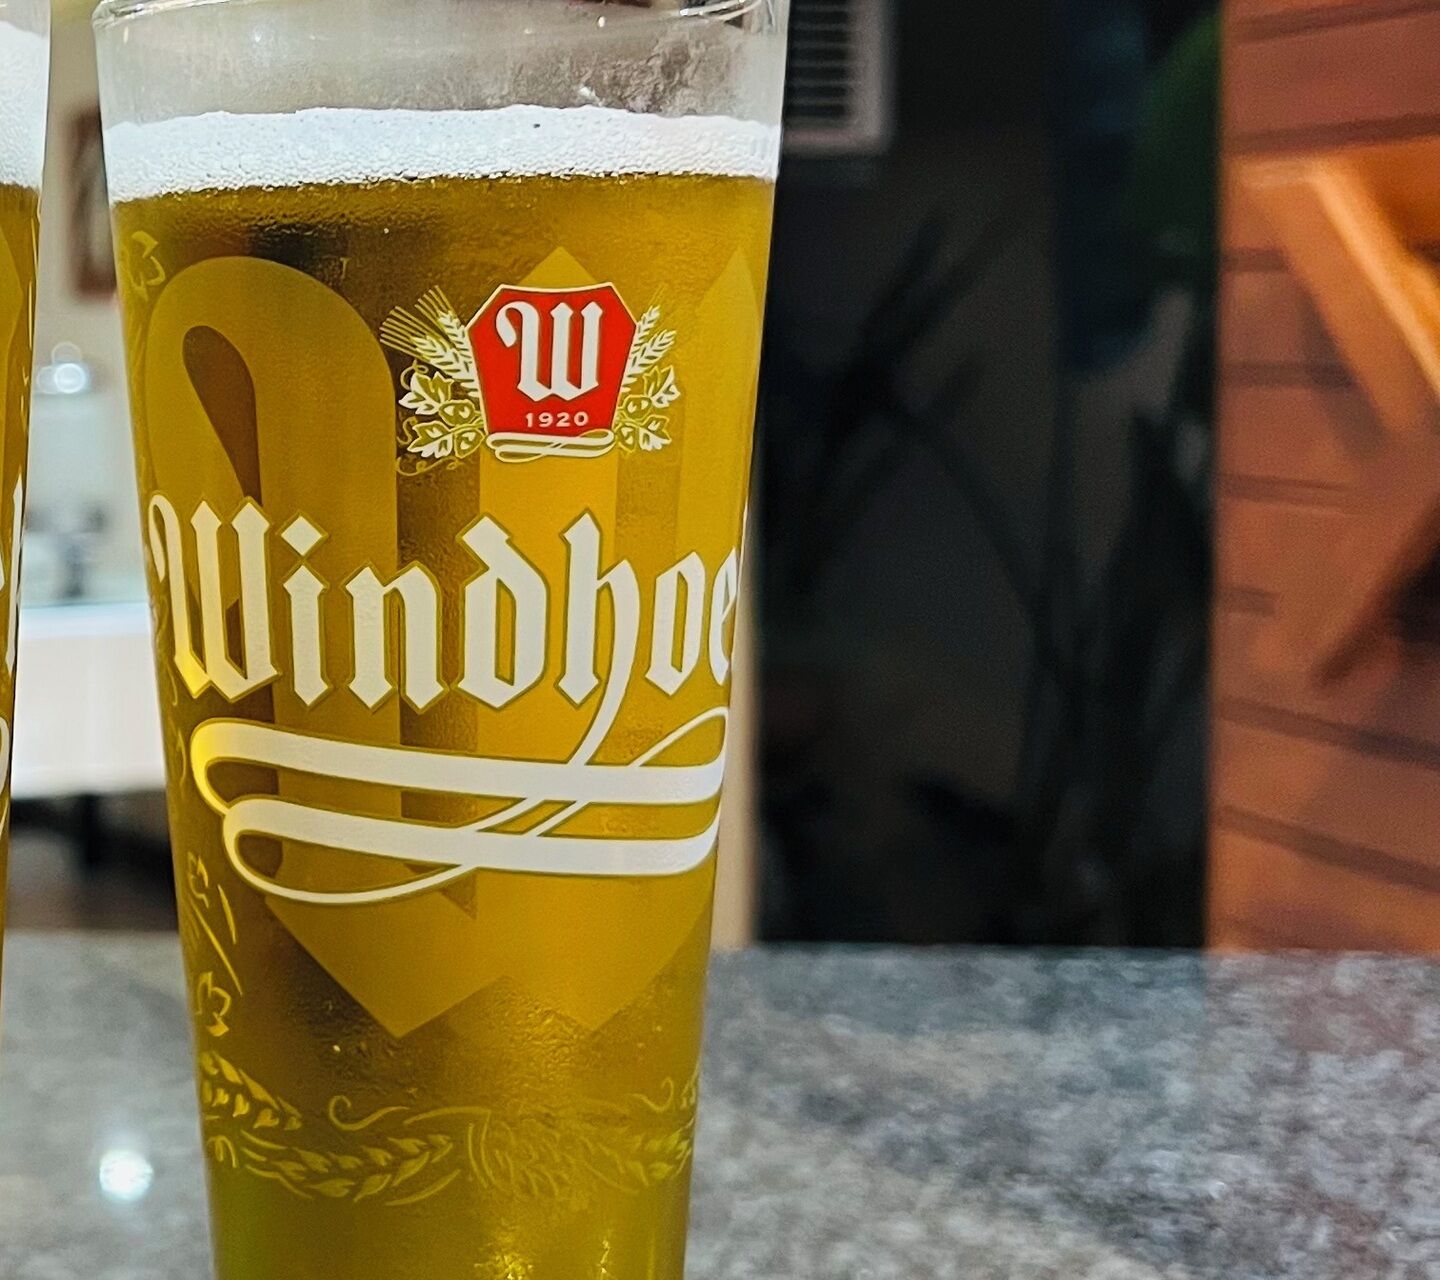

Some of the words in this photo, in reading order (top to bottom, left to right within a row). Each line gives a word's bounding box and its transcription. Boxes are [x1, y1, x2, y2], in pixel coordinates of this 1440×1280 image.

[495, 300, 603, 402] W
[525, 411, 589, 428] 1920
[148, 494, 748, 765] Windhoe
